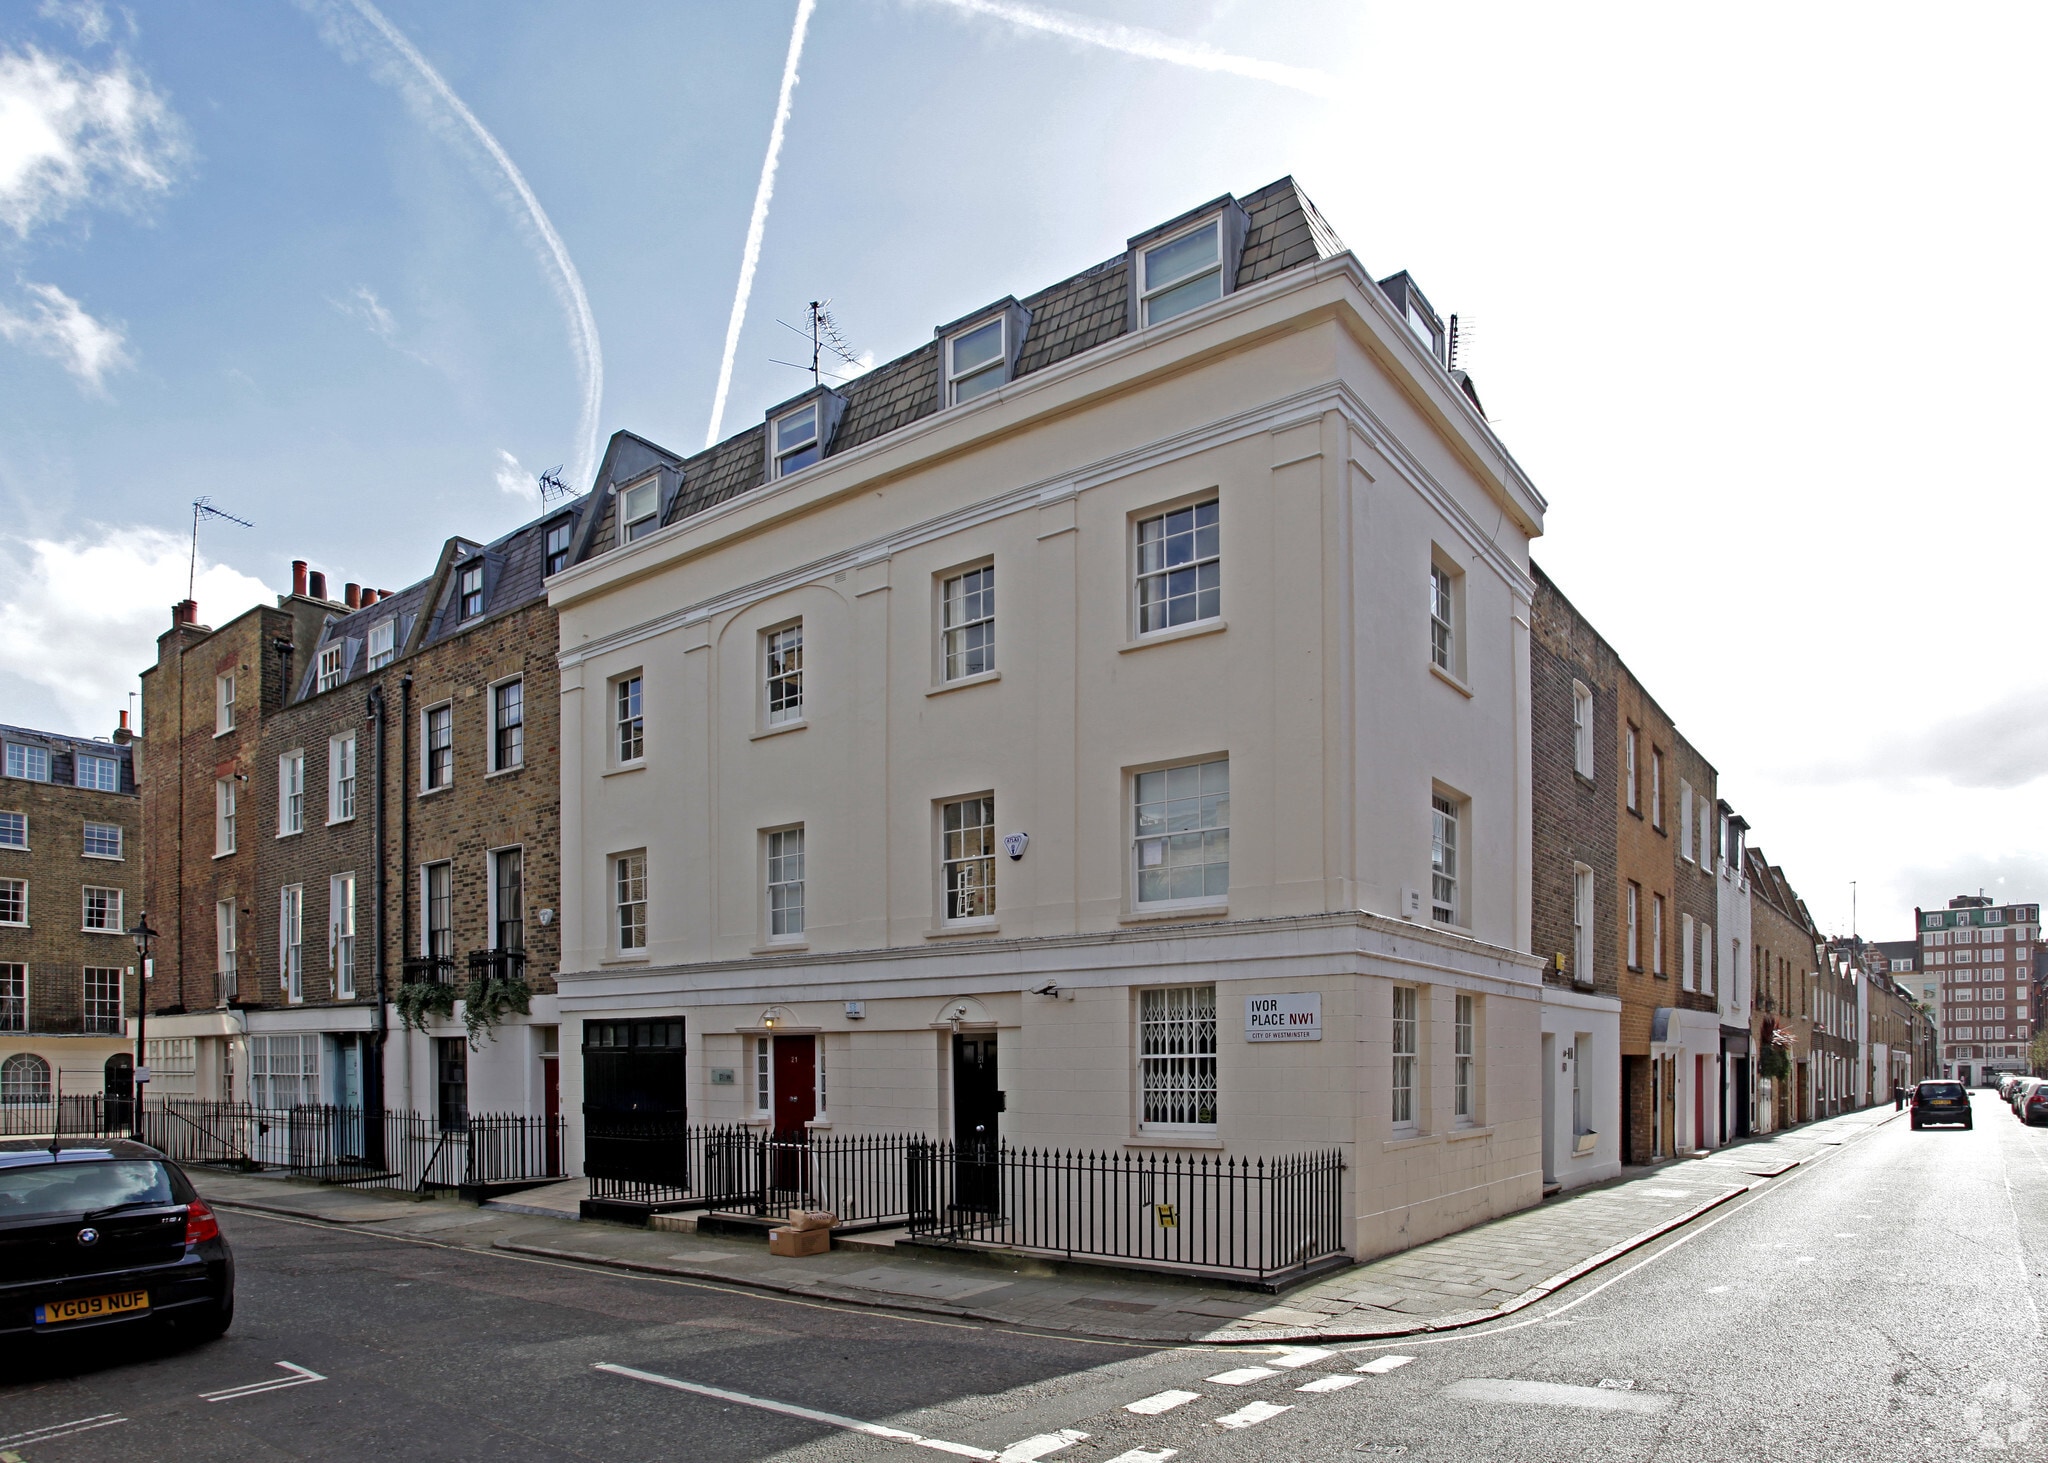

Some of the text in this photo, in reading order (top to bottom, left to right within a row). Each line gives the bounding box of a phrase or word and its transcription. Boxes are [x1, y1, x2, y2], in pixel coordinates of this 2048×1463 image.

[1251, 999, 1277, 1012] IVOR
[1251, 1012, 1314, 1026] PLACE NW1
[978, 1055, 984, 1063] 21
[1158, 1206, 1174, 1225] H
[50, 1291, 145, 1318] YG09 NUF
